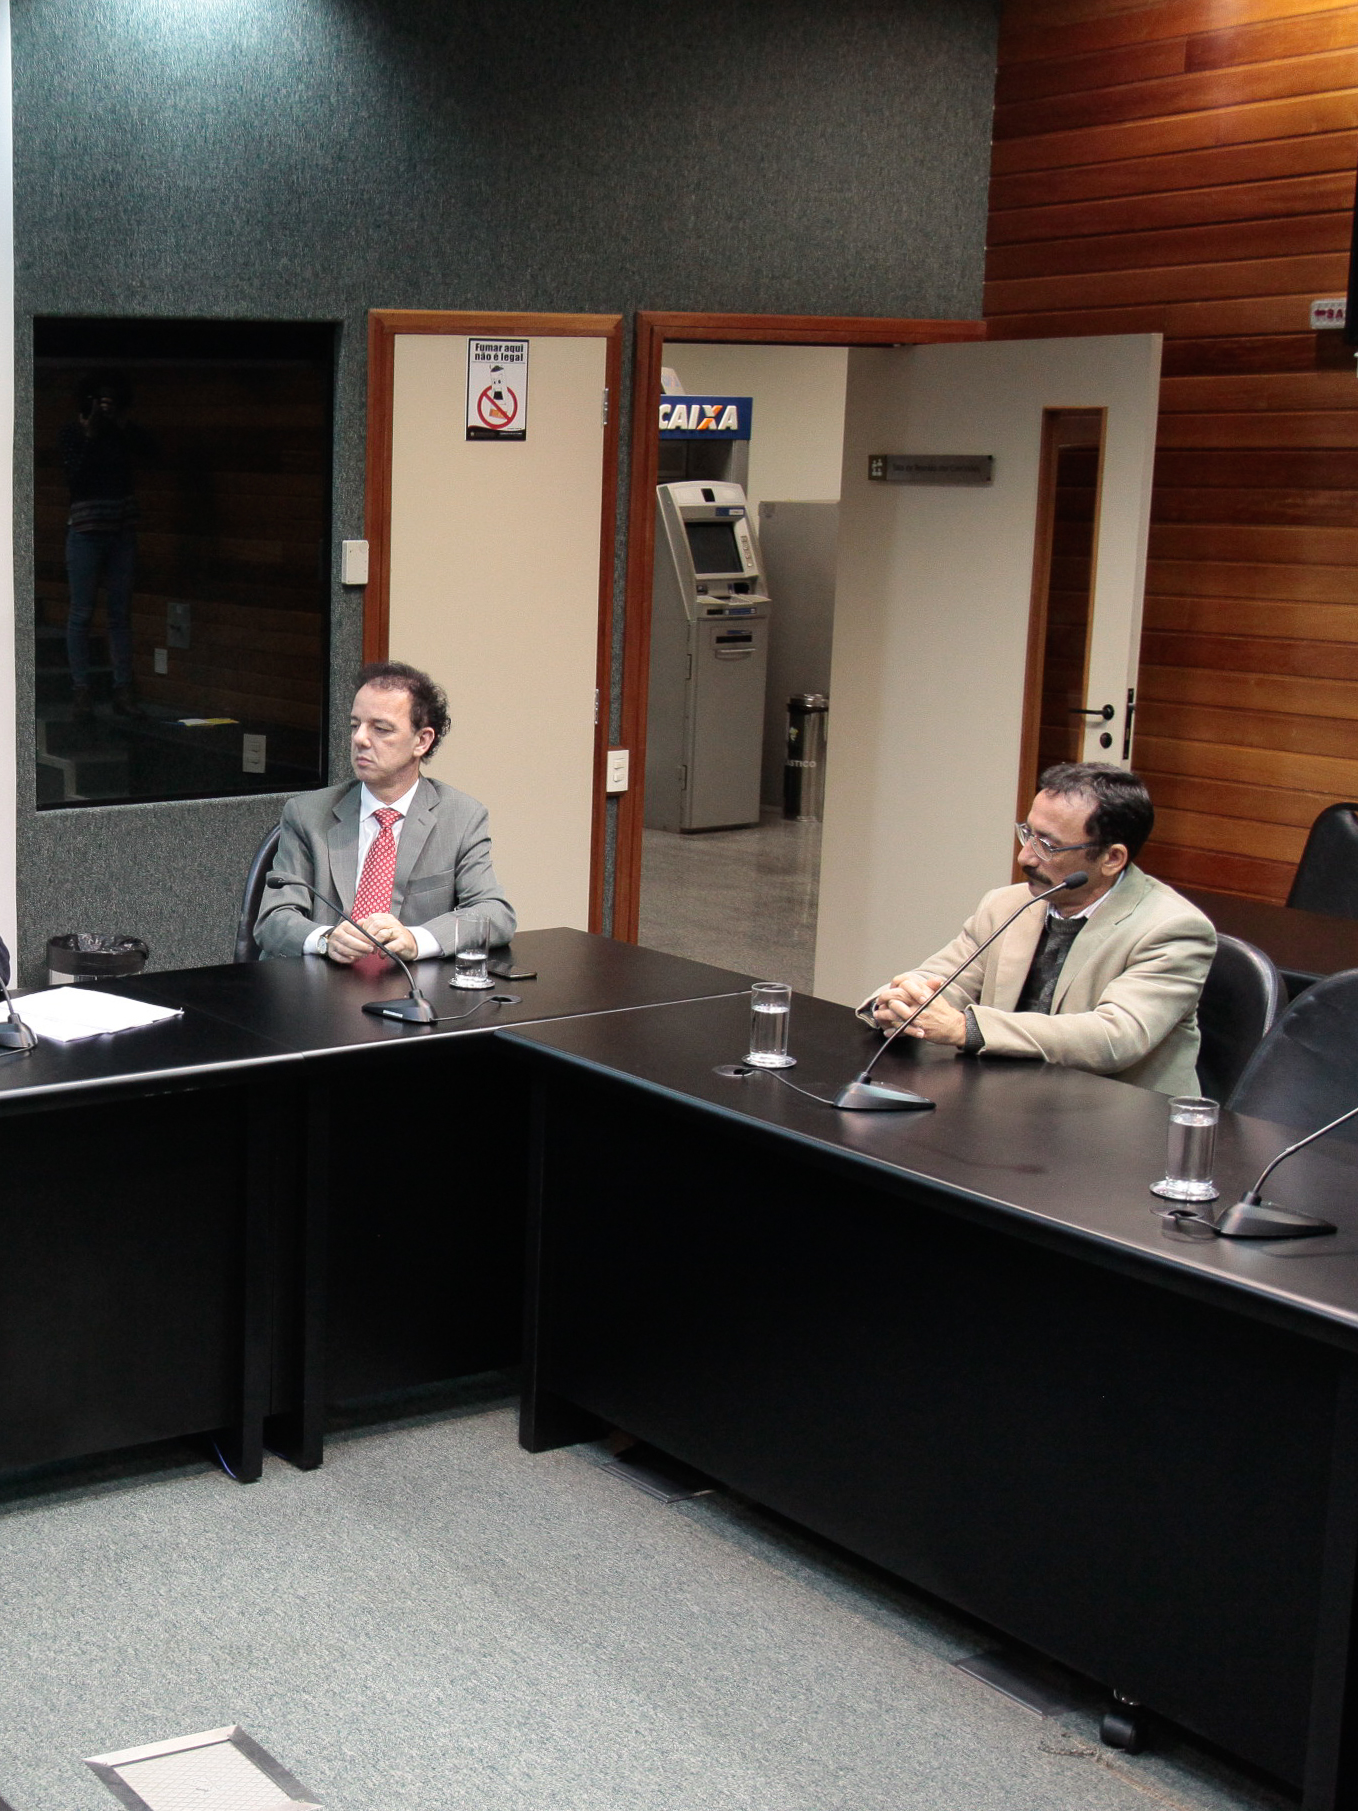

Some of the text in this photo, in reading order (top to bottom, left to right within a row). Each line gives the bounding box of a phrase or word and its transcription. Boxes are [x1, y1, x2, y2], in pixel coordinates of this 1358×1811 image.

[475, 342, 524, 354] Fumar aqui
[474, 353, 524, 363] não é legal
[658, 403, 739, 431] CAIXA
